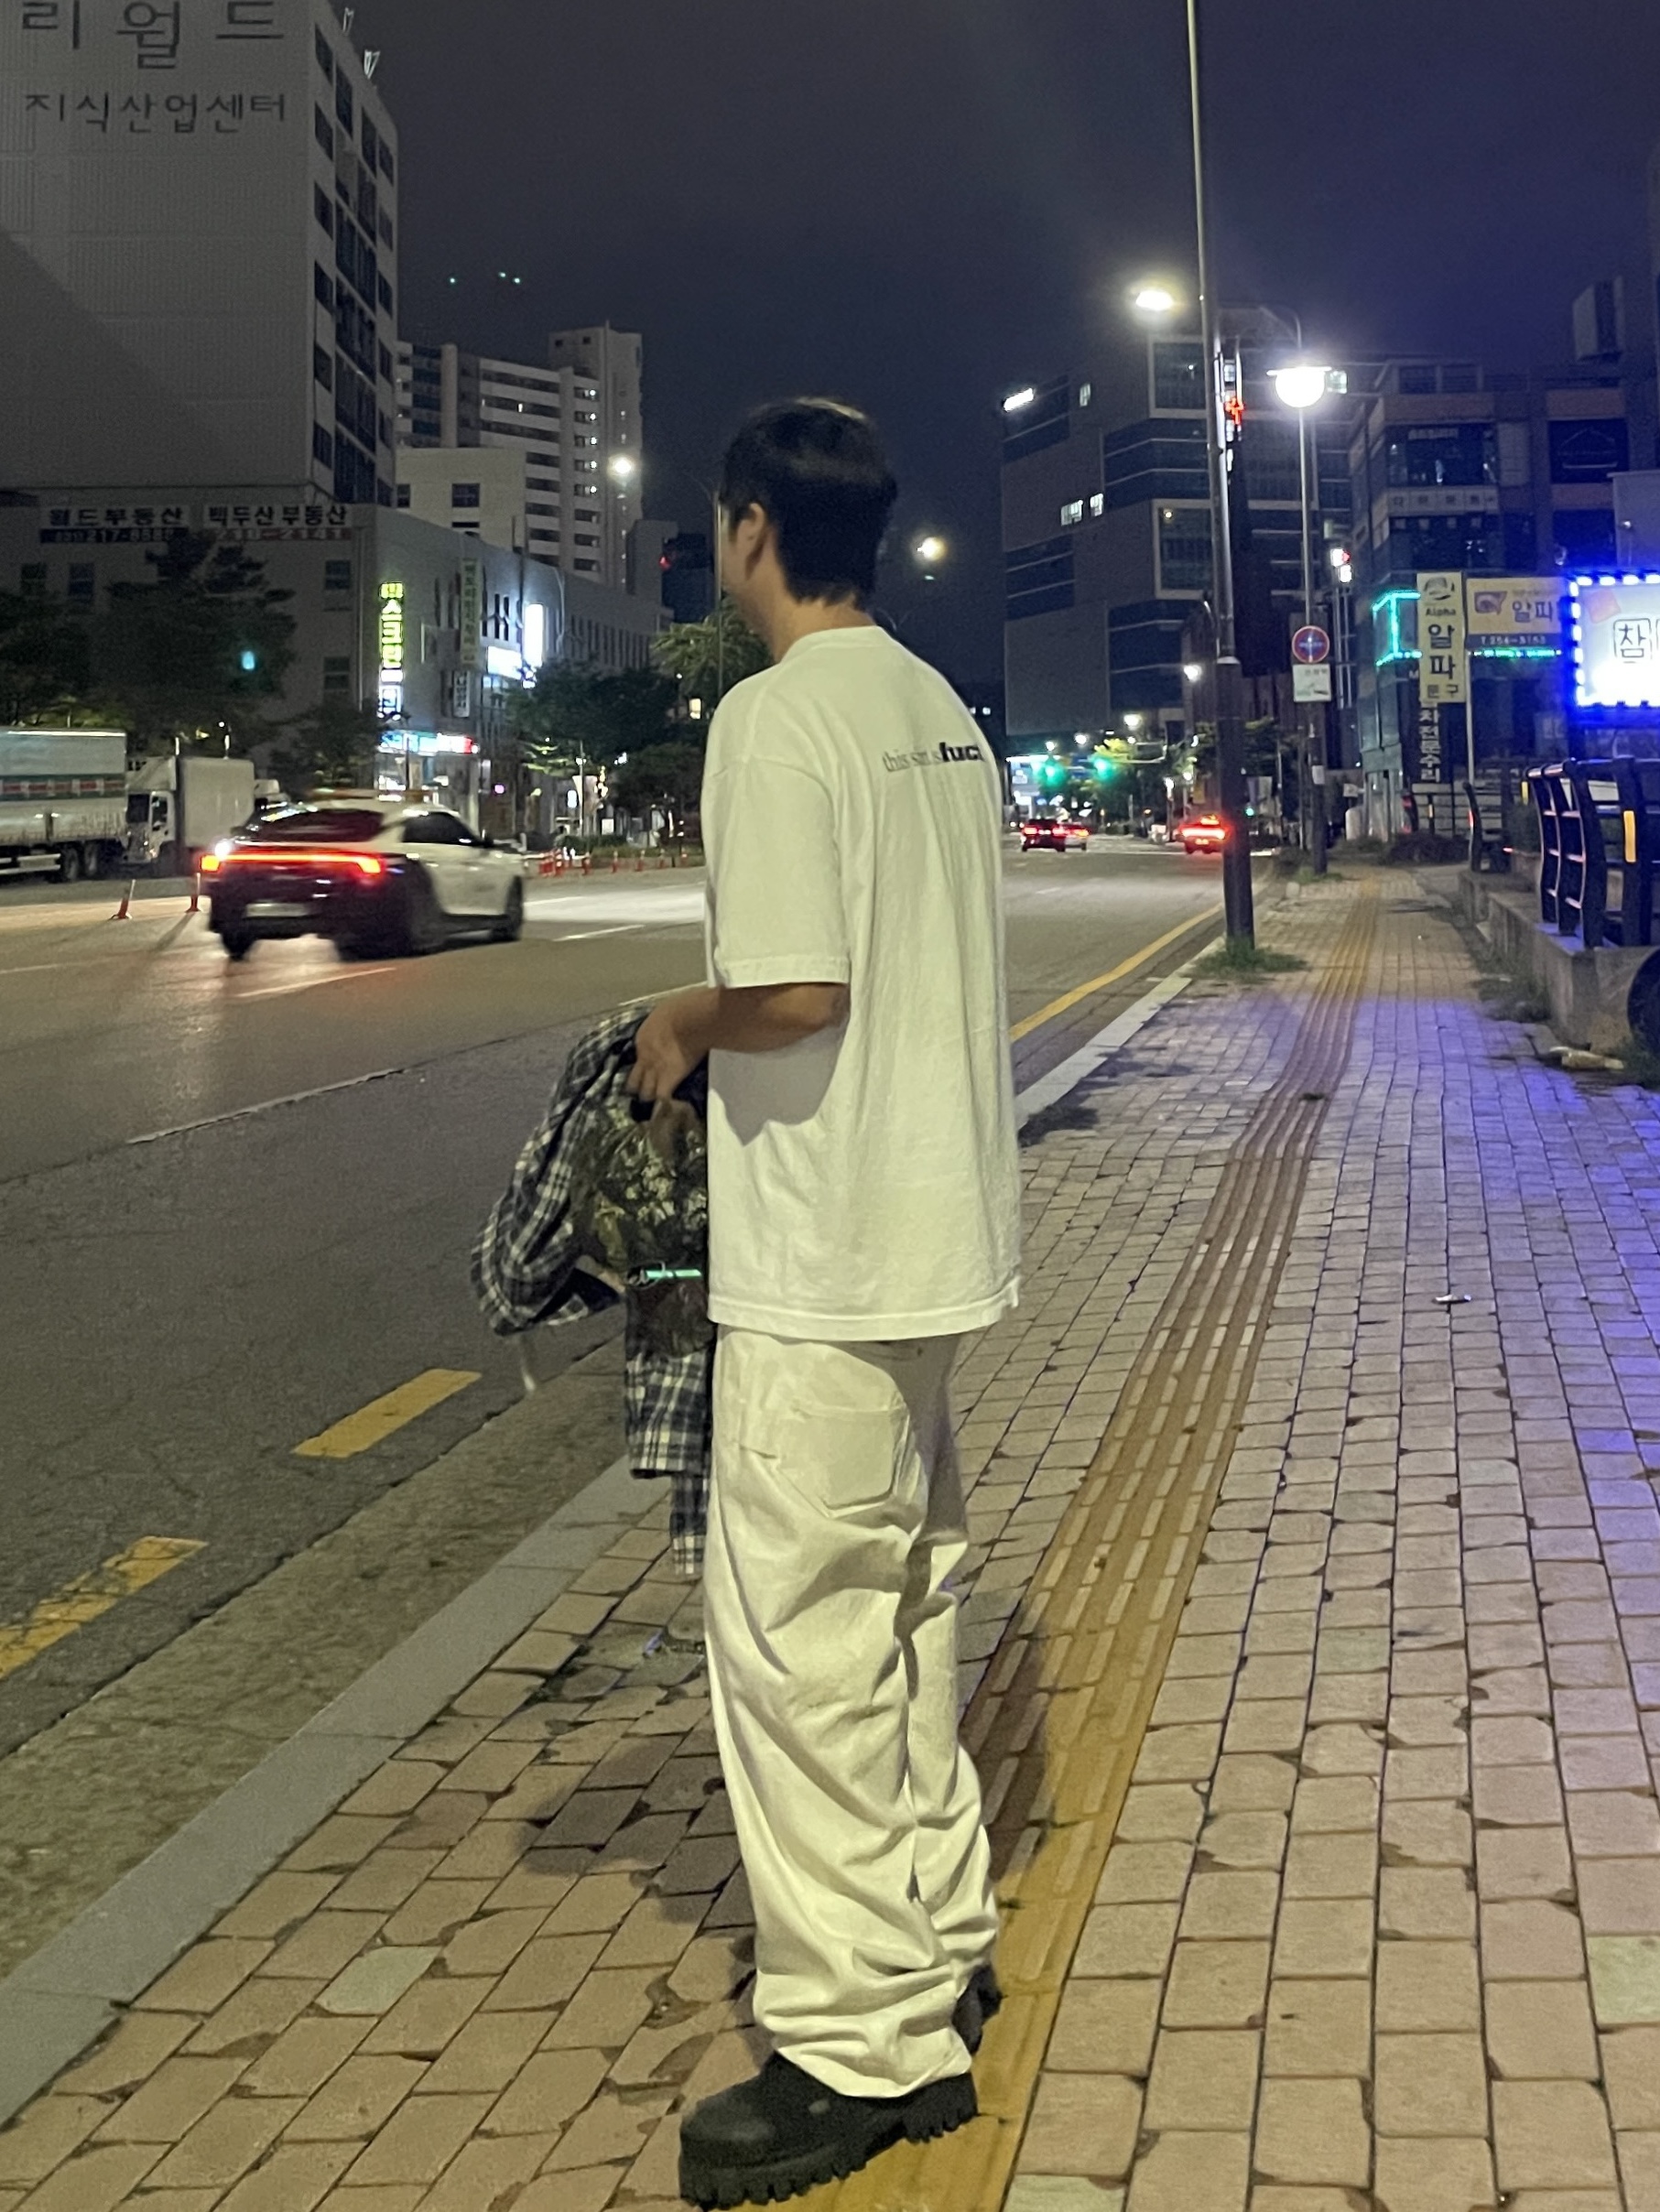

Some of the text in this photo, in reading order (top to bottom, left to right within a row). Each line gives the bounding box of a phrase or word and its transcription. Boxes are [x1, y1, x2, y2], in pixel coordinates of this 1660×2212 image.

[25, 93, 286, 134] 지식산업센터
[209, 505, 348, 526] 백두산 부동산
[1425, 607, 1457, 618] Alpha
[1427, 623, 1456, 680] 알파
[1618, 623, 1647, 658] 참
[1427, 684, 1459, 699] 문구
